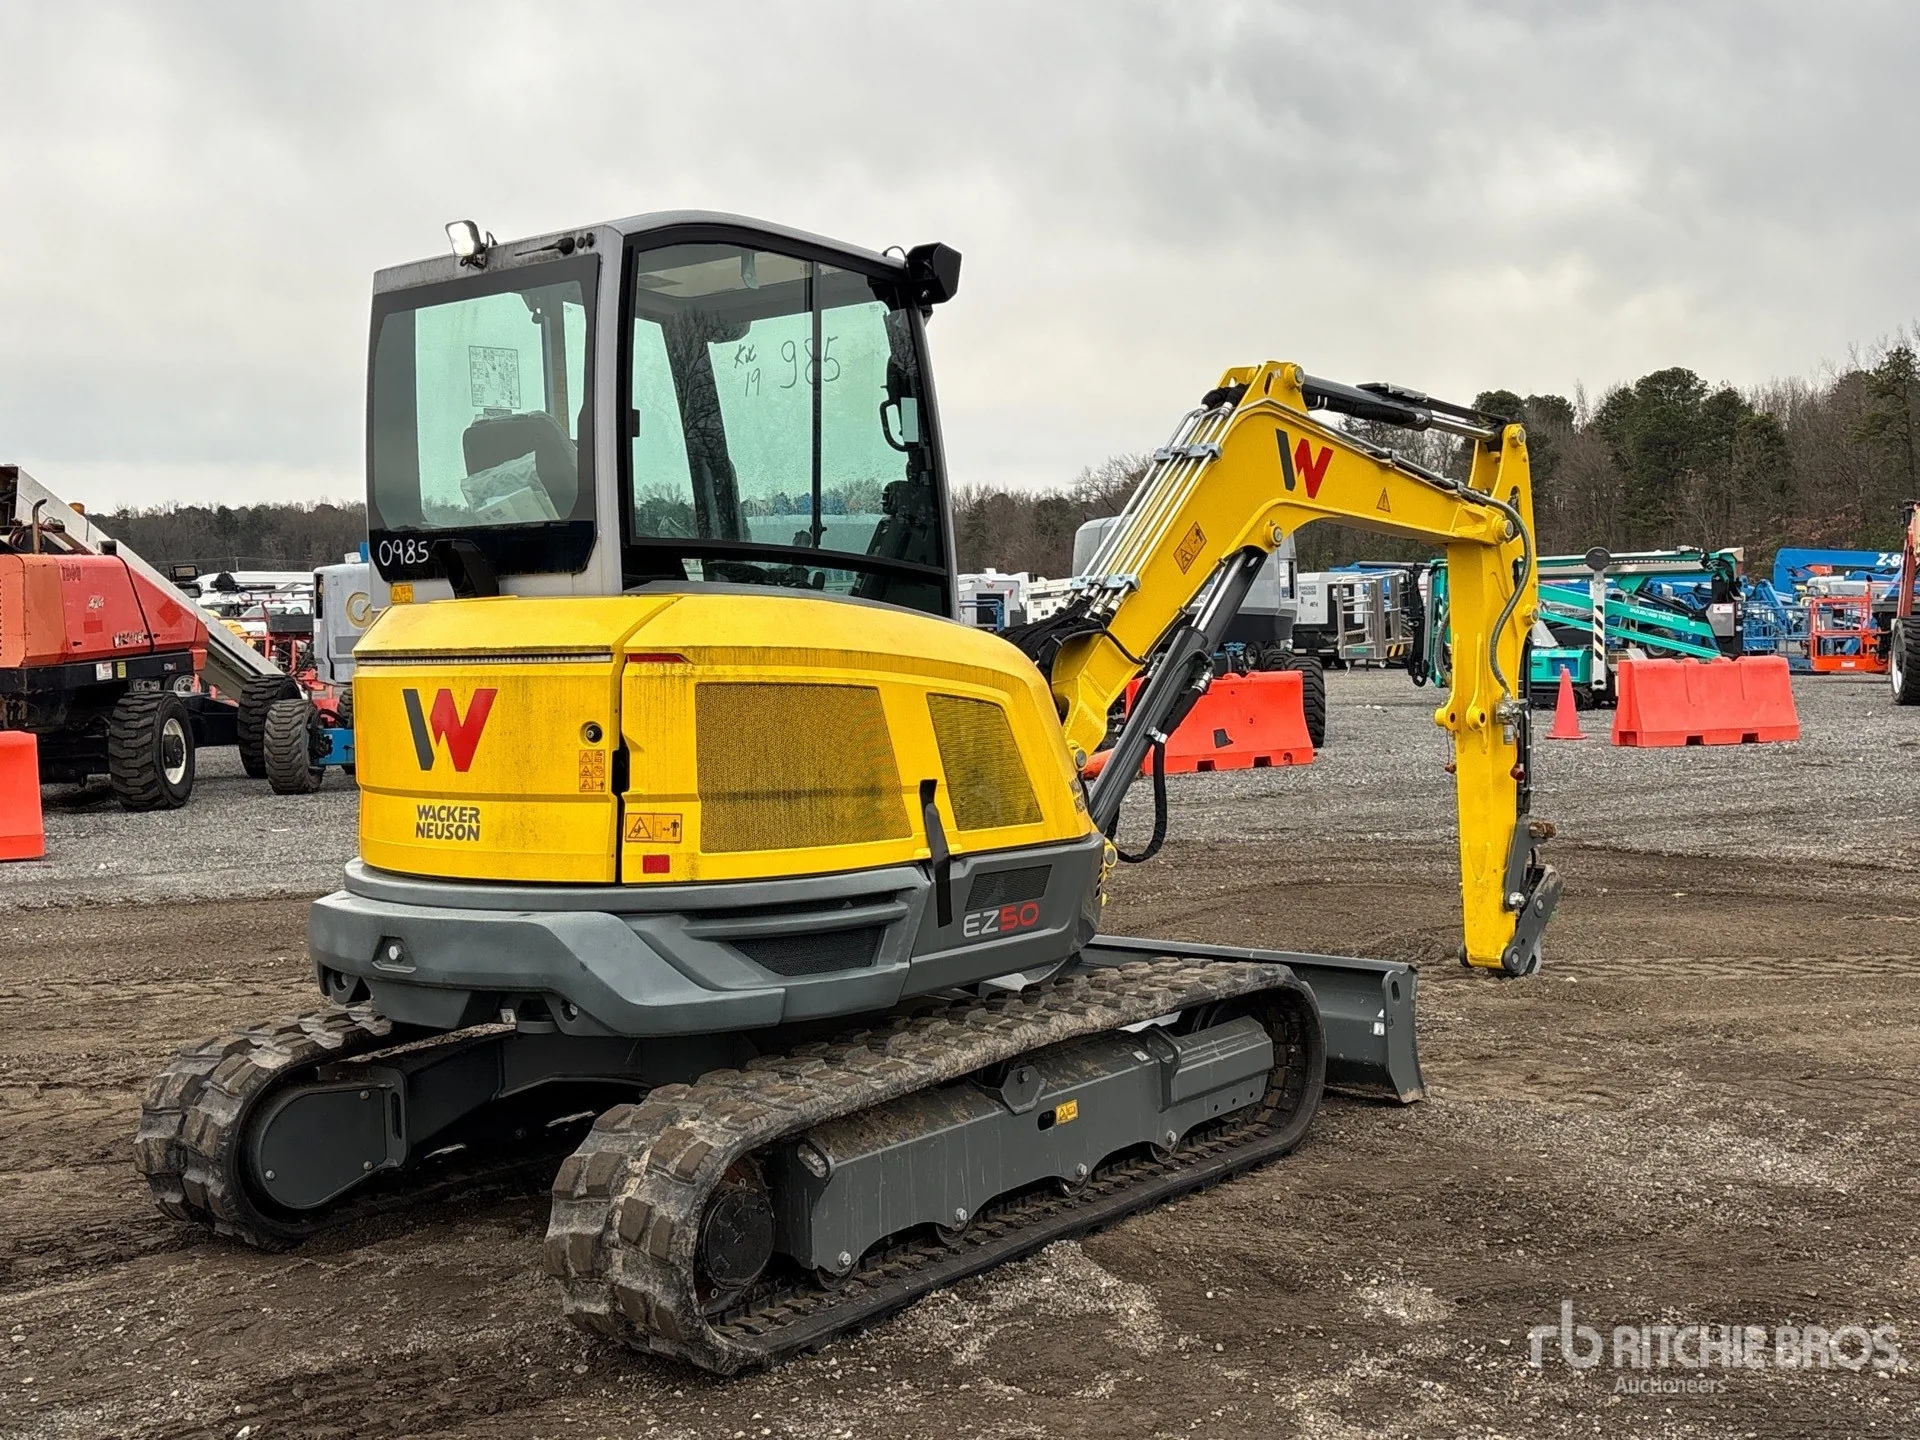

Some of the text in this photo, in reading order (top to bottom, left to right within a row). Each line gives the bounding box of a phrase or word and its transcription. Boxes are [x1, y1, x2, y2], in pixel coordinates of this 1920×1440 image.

[780, 336, 841, 389] 985
[745, 368, 760, 397] 19
[379, 539, 429, 566] 0985
[1876, 553, 1905, 567] Z-8
[402, 688, 499, 772] W
[416, 804, 481, 824] WACKER
[415, 821, 481, 841] NEUSON
[963, 902, 1040, 938] EZ50
